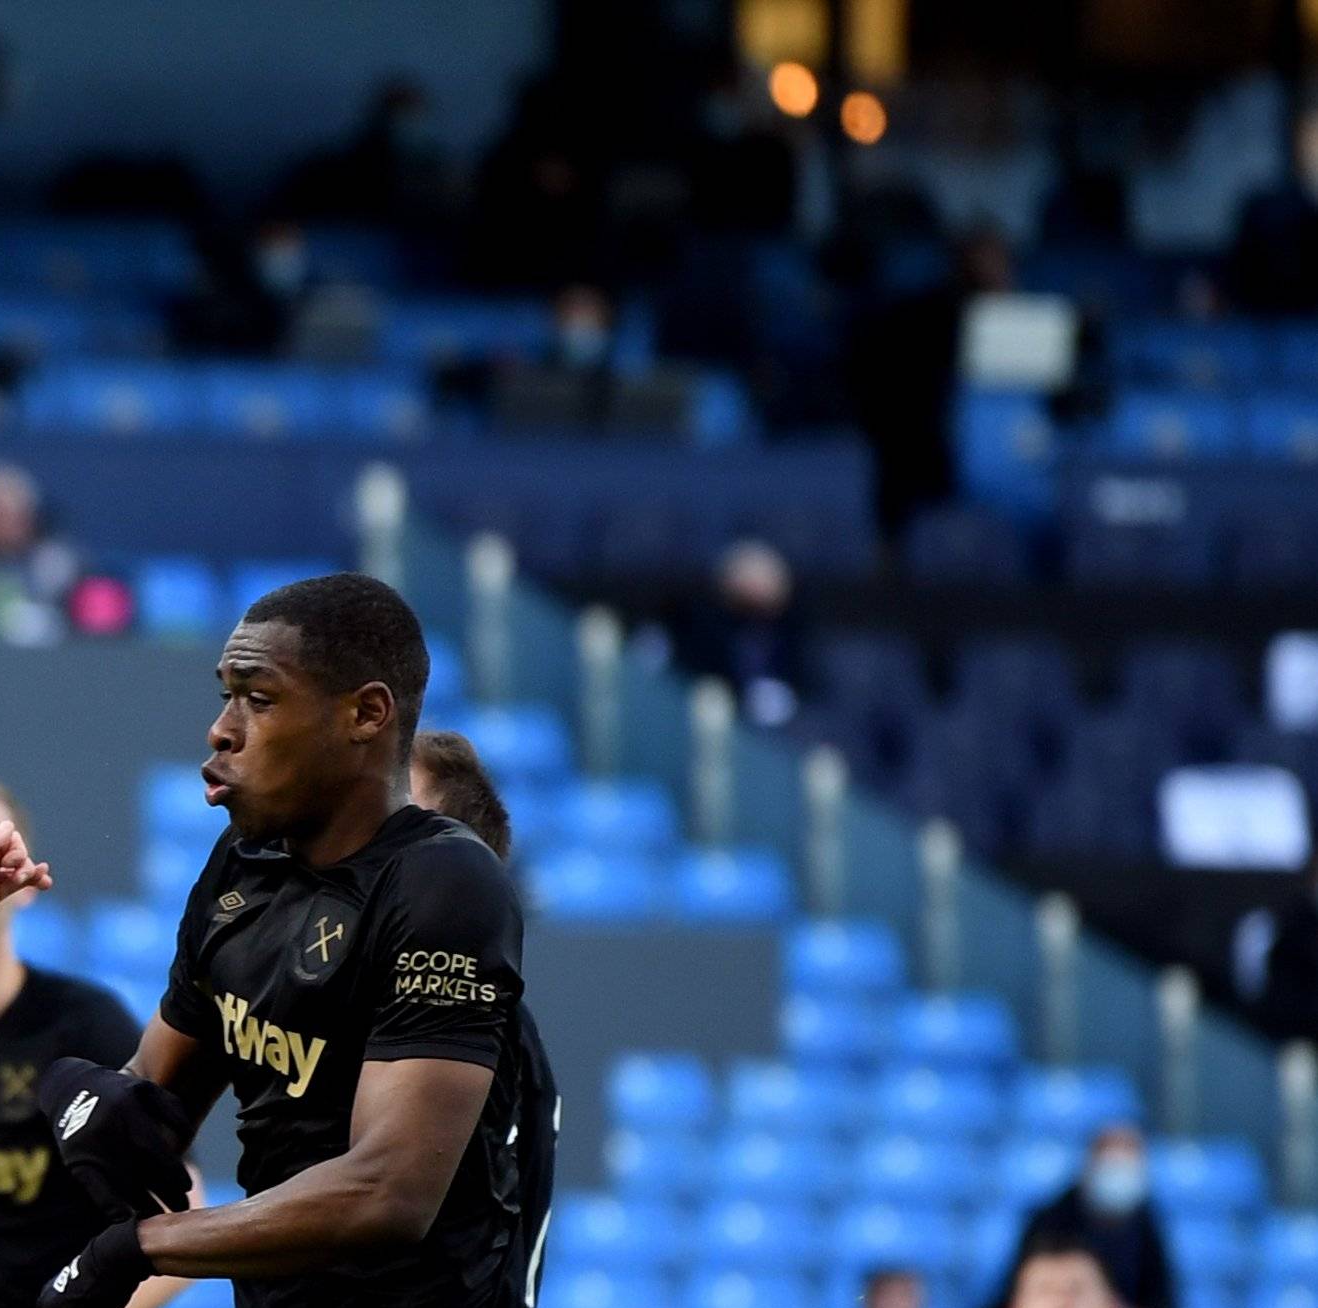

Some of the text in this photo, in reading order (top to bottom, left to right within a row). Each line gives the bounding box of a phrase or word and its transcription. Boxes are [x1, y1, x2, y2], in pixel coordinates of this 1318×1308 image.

[395, 950, 478, 979] SCOPE
[394, 974, 497, 1003] MARKETS
[214, 991, 327, 1098] tway
